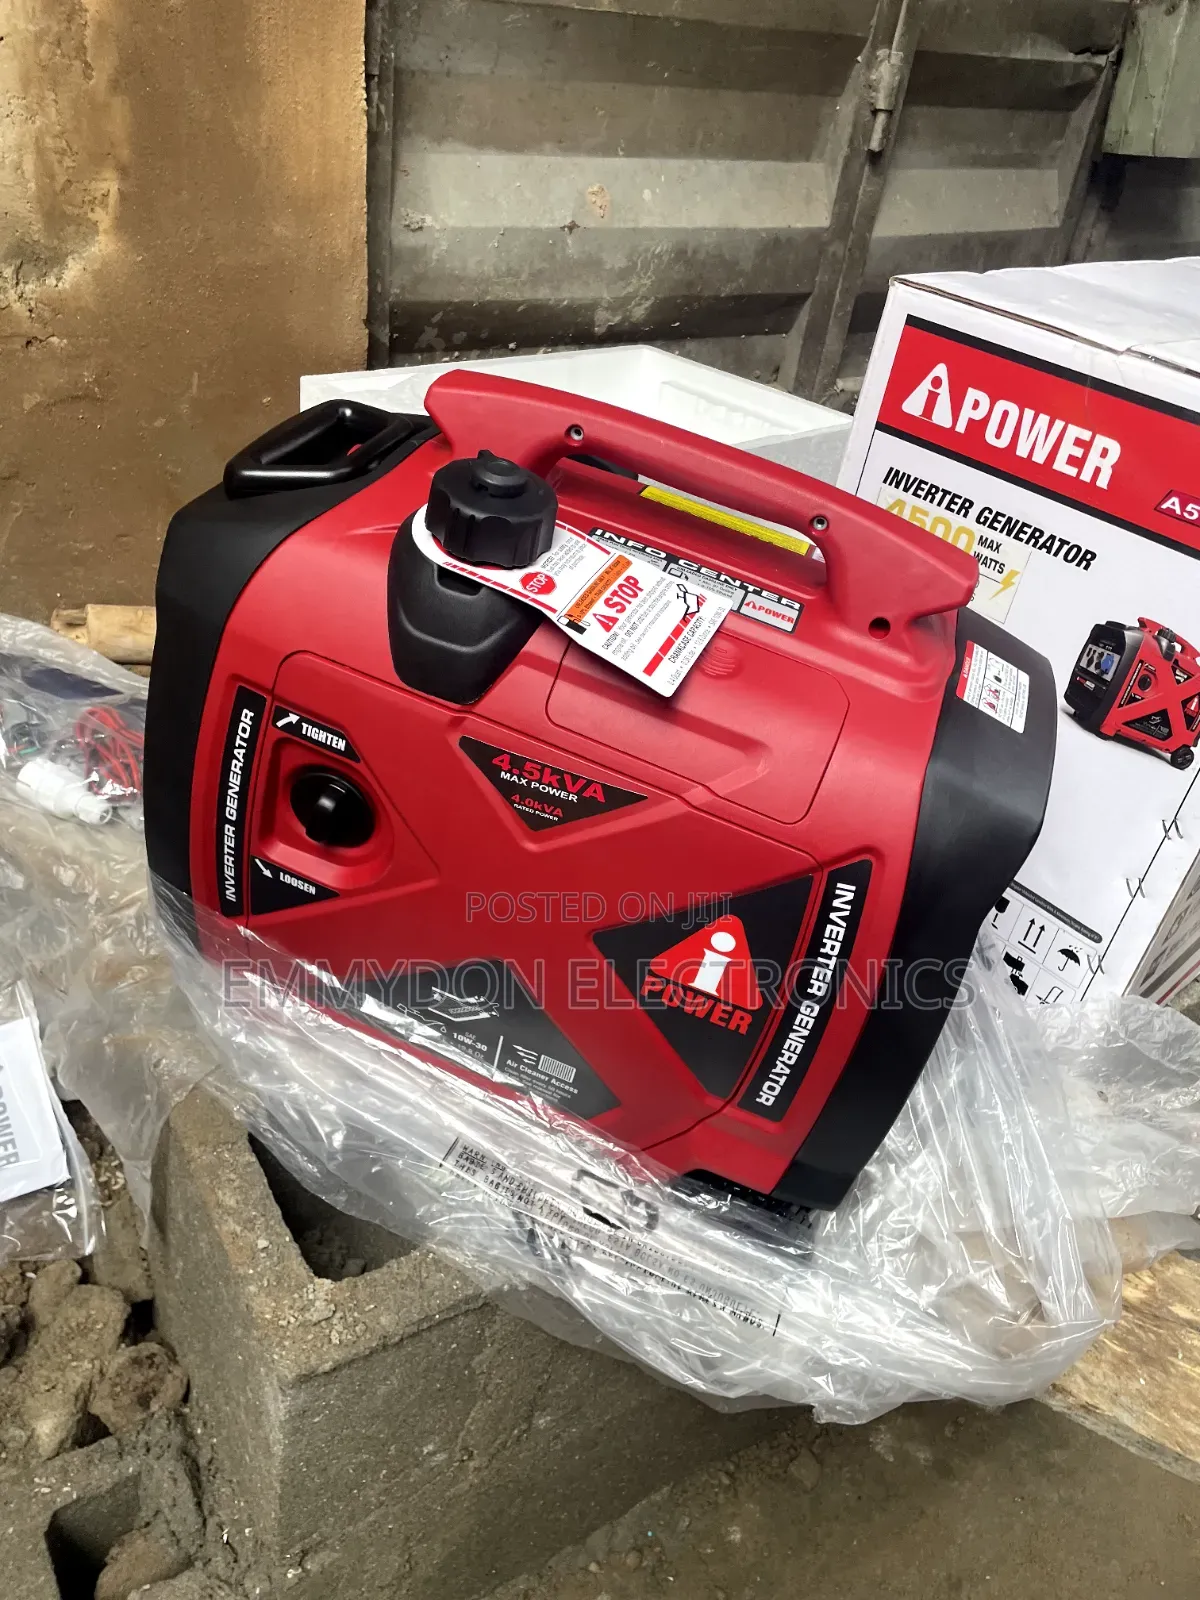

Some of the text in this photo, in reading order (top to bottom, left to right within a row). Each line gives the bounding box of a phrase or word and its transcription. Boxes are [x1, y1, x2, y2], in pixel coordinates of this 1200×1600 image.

[955, 387, 1121, 490] POWER
[882, 466, 1096, 571] INVERTER GENERATOR
[977, 535, 1003, 554] MAX
[594, 527, 667, 559] INFO
[677, 558, 801, 610] CENTER
[973, 551, 1006, 575] WATTS
[526, 573, 549, 593] STOP
[602, 575, 644, 614] STOP
[757, 604, 795, 624] POWER
[667, 634, 691, 663] CRANKCASE
[301, 722, 346, 751] TIGHTEN
[492, 753, 605, 803] 4.5kVA
[500, 771, 578, 803] MAX POWER
[224, 708, 254, 902] INVERTER GENERATOR
[511, 794, 563, 817] 4.0kVA
[513, 803, 559, 821] RATED POWER
[279, 871, 316, 896] LOOSEN
[640, 974, 753, 1035] POWER
[756, 882, 856, 1106] INVERTER GENERATOR
[451, 1031, 487, 1051] 10W-30
[464, 1031, 477, 1040] SAE
[506, 1058, 578, 1094] Air Cleaner Access
[452, 1158, 477, 1177] THIS
